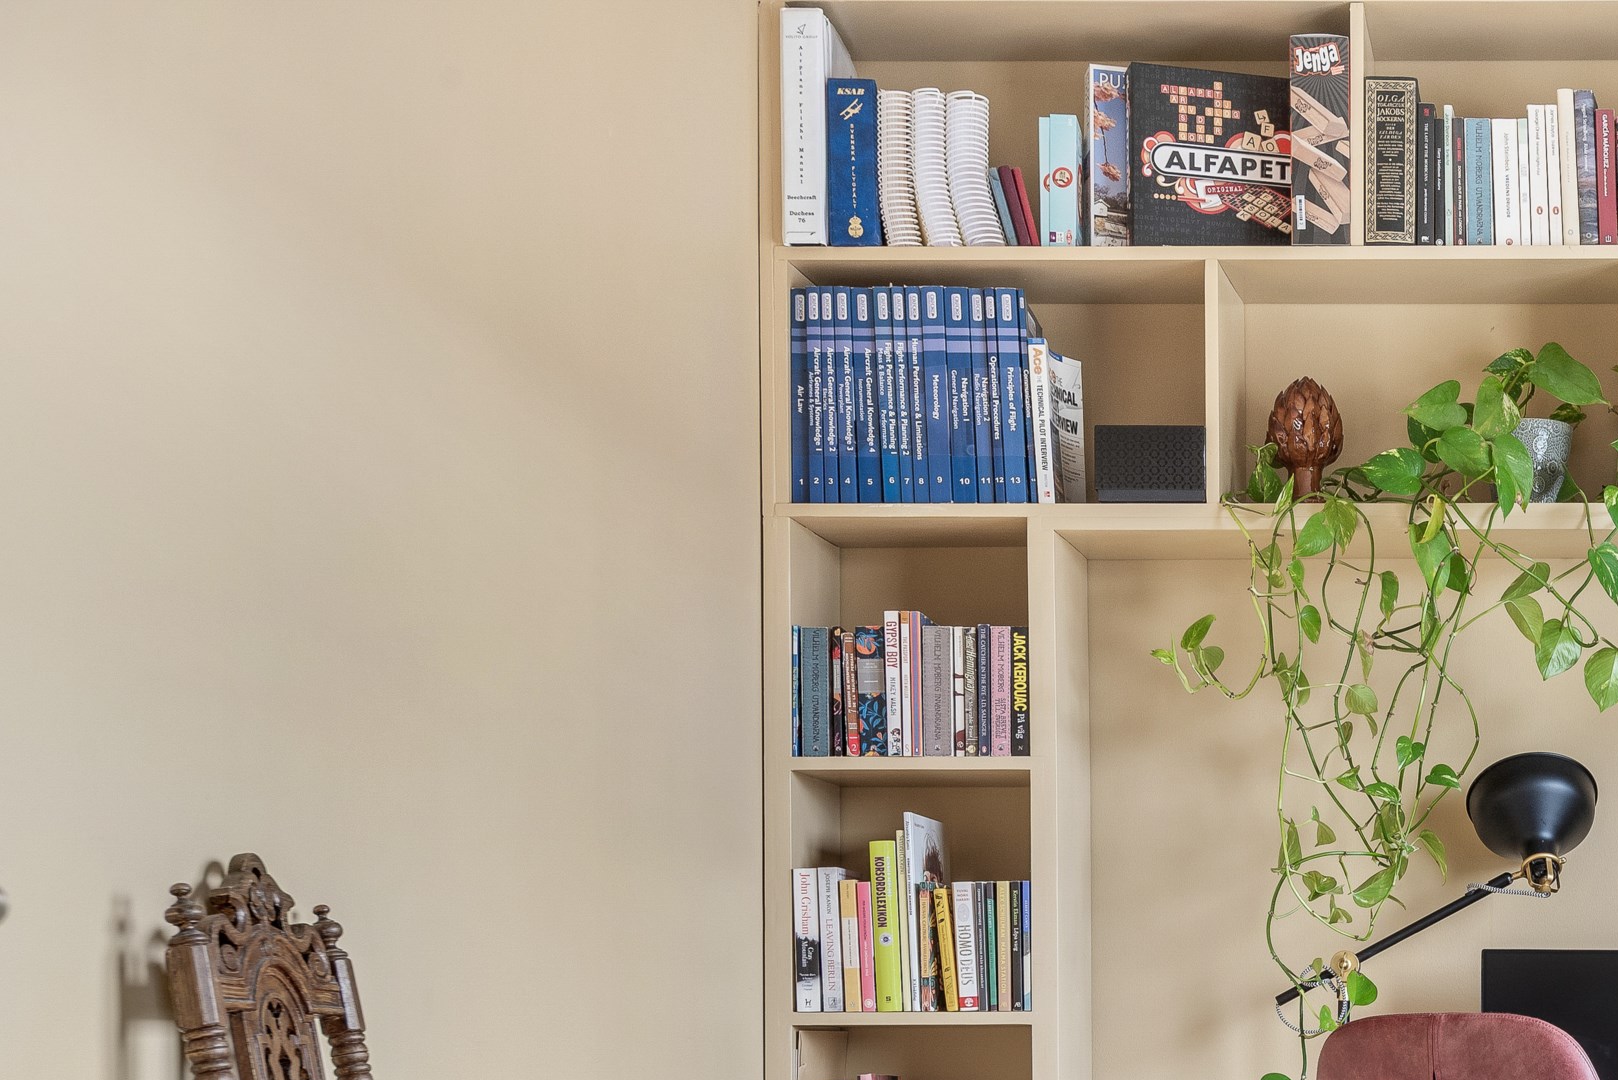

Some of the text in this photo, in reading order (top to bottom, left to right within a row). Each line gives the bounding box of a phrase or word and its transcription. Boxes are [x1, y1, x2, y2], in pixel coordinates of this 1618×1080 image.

[1295, 44, 1339, 73] Jenga
[836, 87, 866, 96] KSAB
[1376, 94, 1405, 103] OLGA
[1376, 108, 1405, 117] JAKOBS
[1475, 122, 1483, 152] VILHELM
[1164, 149, 1291, 179] ALFAPET
[1475, 155, 1483, 184] MOBERG
[1206, 184, 1243, 193] ORIGINAL
[827, 347, 835, 375] Aircraft
[864, 348, 872, 375] Aircraft
[911, 338, 919, 365] Human
[828, 376, 836, 404] General
[865, 377, 873, 405] General
[912, 366, 921, 412] Performance
[932, 375, 941, 420] Meteorology
[989, 356, 1001, 440] Operational Procedures
[1007, 367, 1015, 401] Principles
[828, 406, 836, 446] Knowledge
[867, 407, 875, 447] Knowledge
[952, 396, 960, 430] Navigation
[1009, 411, 1017, 432] Flight
[812, 629, 820, 660] VILHELM
[886, 621, 898, 669] GYPSY BOY
[997, 629, 1005, 661] VILHELM
[812, 662, 820, 692] MOBERG
[933, 629, 942, 740] VILHELM MOBERG INVANDRARNA
[1013, 632, 1027, 739] JACK KEROUAC På väg
[799, 872, 812, 936] John Grisham
[875, 856, 887, 928] KORSORDSLEXIKON
[825, 918, 834, 957] LEAVING
[801, 940, 809, 967] Mountain
[958, 925, 975, 986] HOMO DEUS
[827, 959, 836, 991] BERLIN
